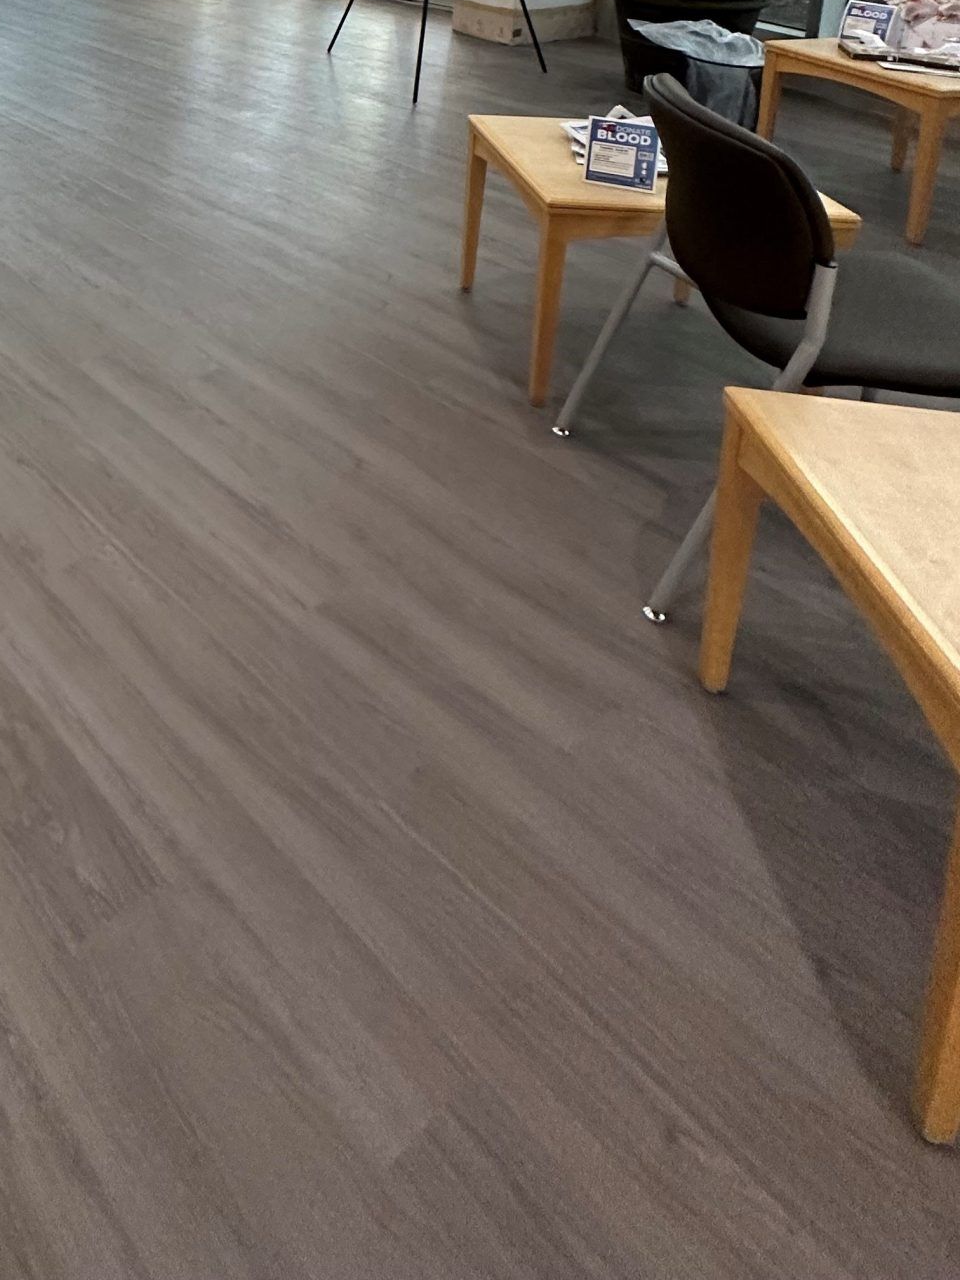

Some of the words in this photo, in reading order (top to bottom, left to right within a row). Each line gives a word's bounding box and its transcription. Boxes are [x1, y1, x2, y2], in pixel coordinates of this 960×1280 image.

[850, 8, 888, 19] BLOOD
[616, 125, 652, 136] DONATE
[597, 129, 651, 145] BLOOD
